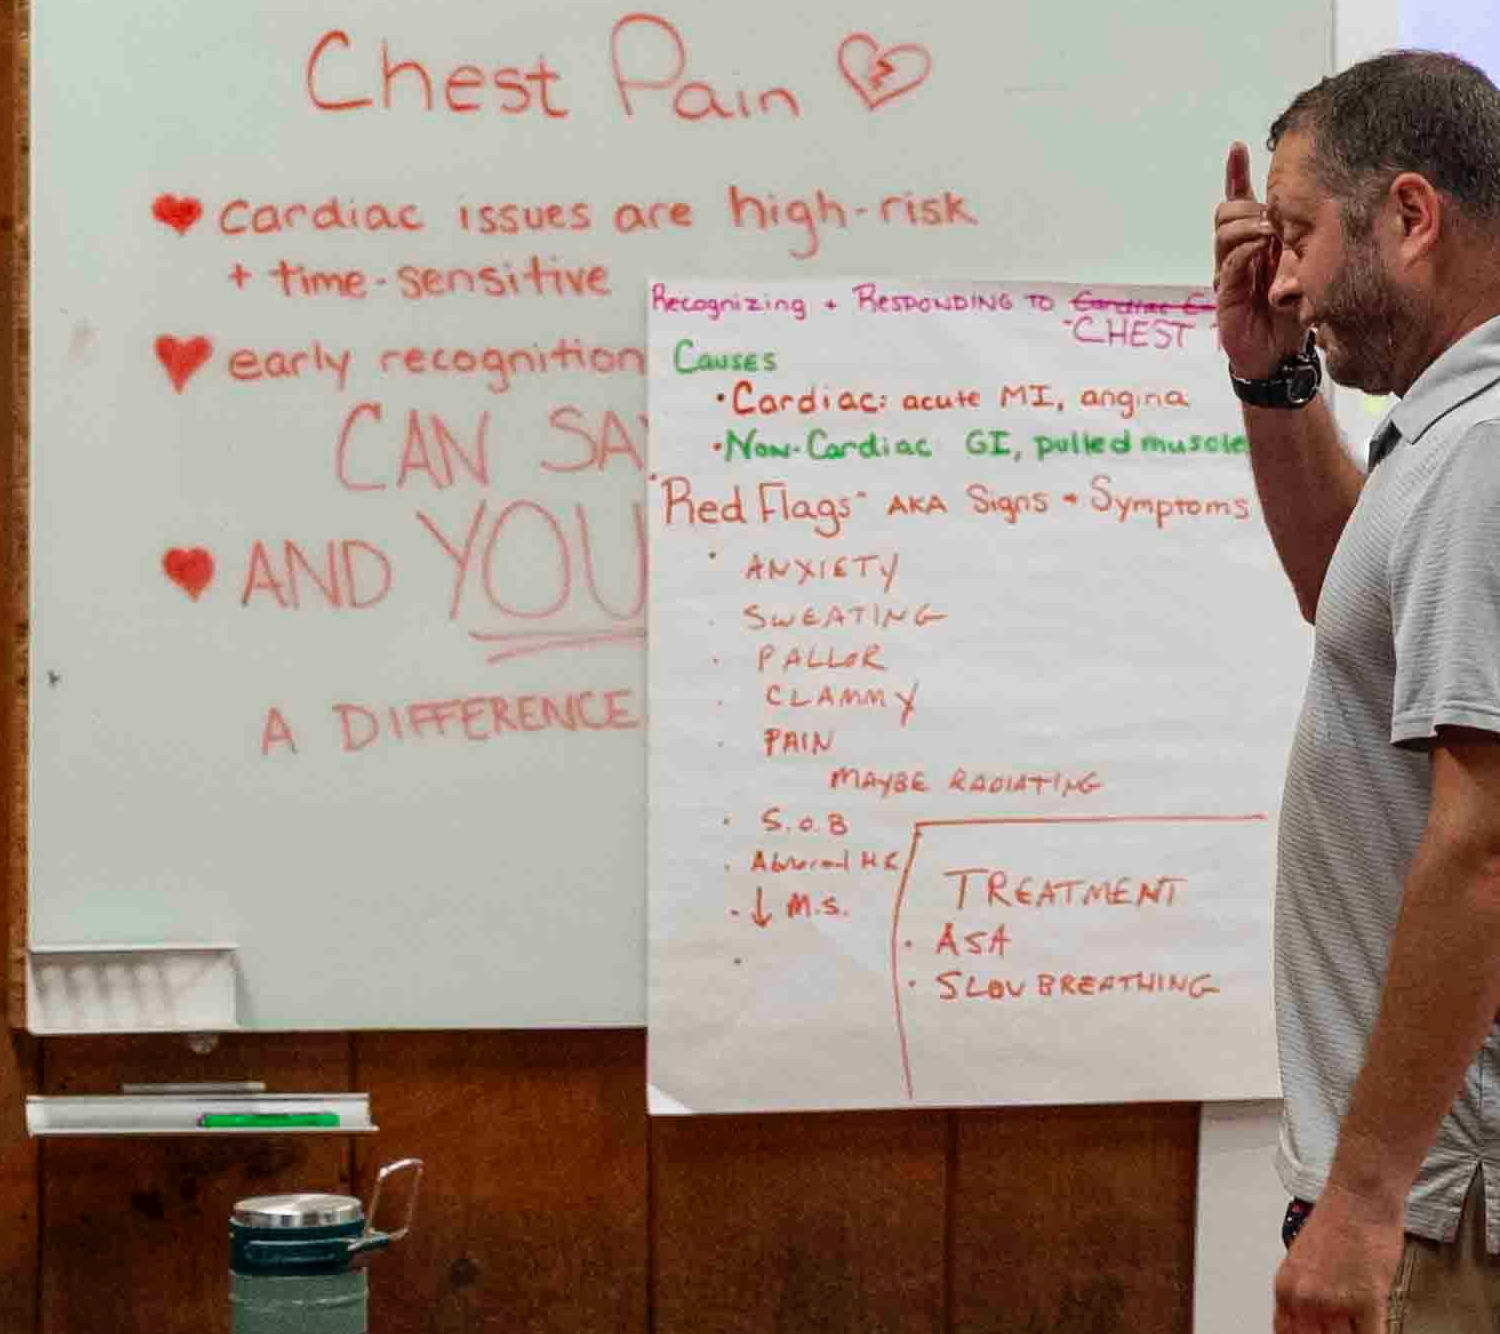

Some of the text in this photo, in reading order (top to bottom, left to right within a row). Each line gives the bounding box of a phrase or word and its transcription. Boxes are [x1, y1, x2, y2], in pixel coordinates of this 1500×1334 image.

[307, 12, 801, 121] Chest Pain
[458, 200, 591, 234] issues
[615, 201, 694, 233] are
[728, 184, 980, 260] high-risk
[269, 256, 612, 298] time-sensitive
[651, 282, 807, 321] Recognizing
[228, 338, 647, 394] early recognition
[902, 389, 981, 412] acute
[1080, 387, 1191, 421] angina
[334, 402, 649, 492] CAN SA
[1033, 429, 1133, 463] pulled
[886, 494, 950, 516] AKA
[965, 481, 1050, 525] Signs
[1090, 473, 1251, 530] Symptoms
[242, 539, 392, 609] AND
[745, 552, 901, 595] ANXIETY
[742, 602, 950, 631] SWEATING
[756, 642, 889, 674] PALLOR
[261, 687, 641, 754] A DIFFERENCE
[765, 678, 920, 728] CLAMMY
[763, 727, 836, 759] PAIN
[828, 766, 1104, 799] MAYBE RADIATING
[943, 867, 1190, 911] TREATMENT
[936, 922, 1012, 958] ASA
[1036, 970, 1221, 999] BREATHING
